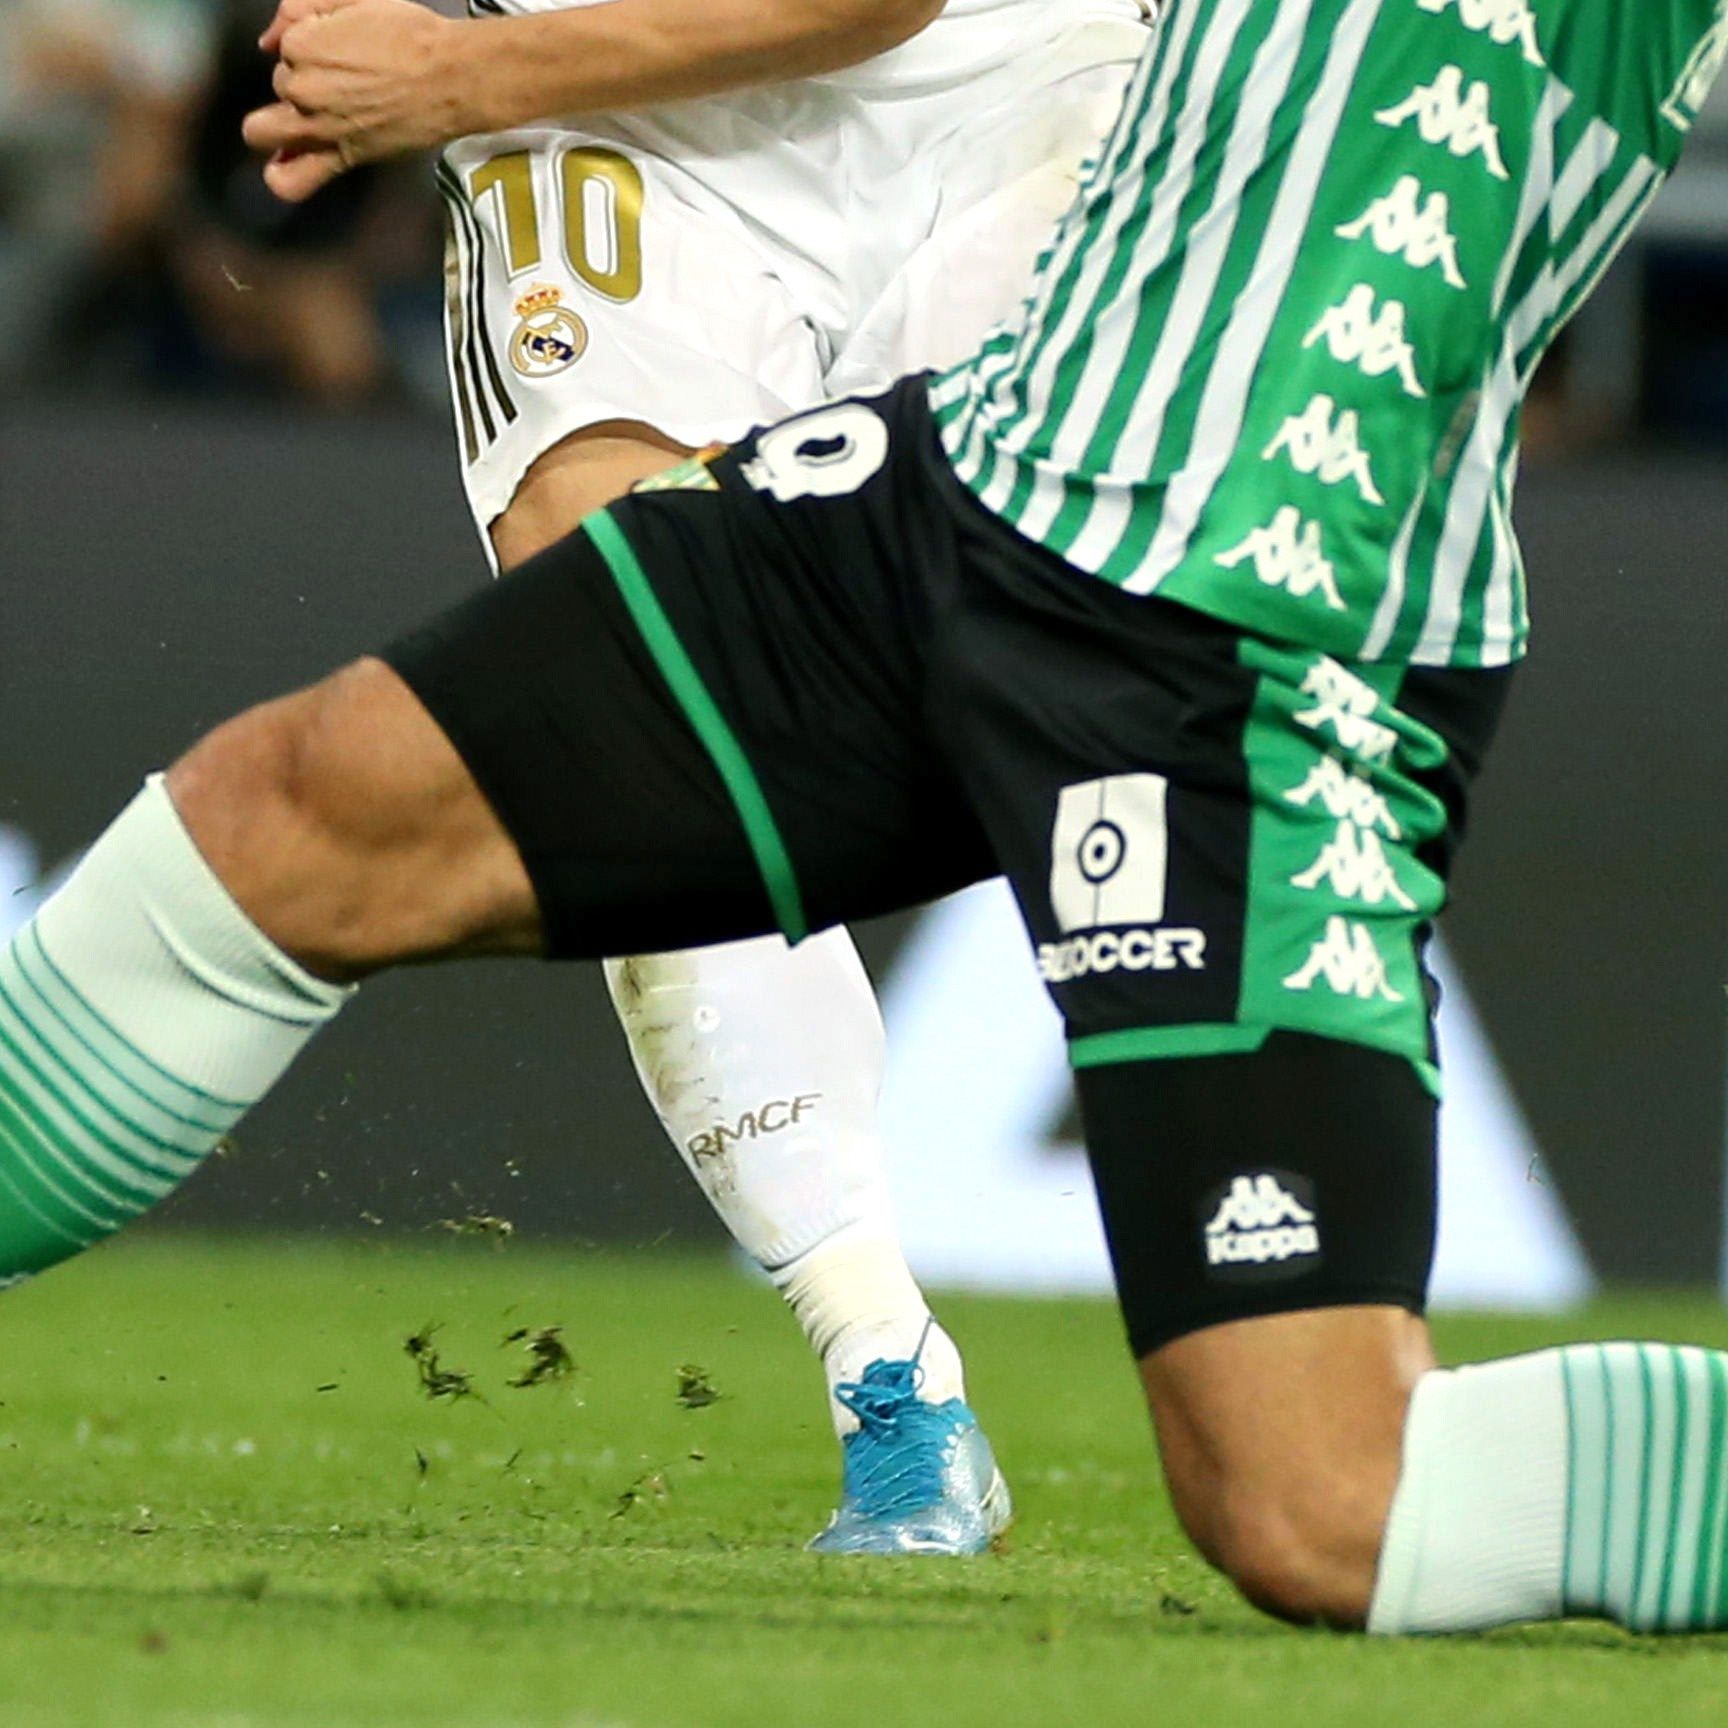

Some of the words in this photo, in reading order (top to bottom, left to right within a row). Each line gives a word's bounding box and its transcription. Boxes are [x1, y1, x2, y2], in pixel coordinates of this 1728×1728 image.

[467, 146, 644, 305] 10
[687, 1092, 824, 1169] RMCF
[1205, 1223, 1320, 1265] Kappa
